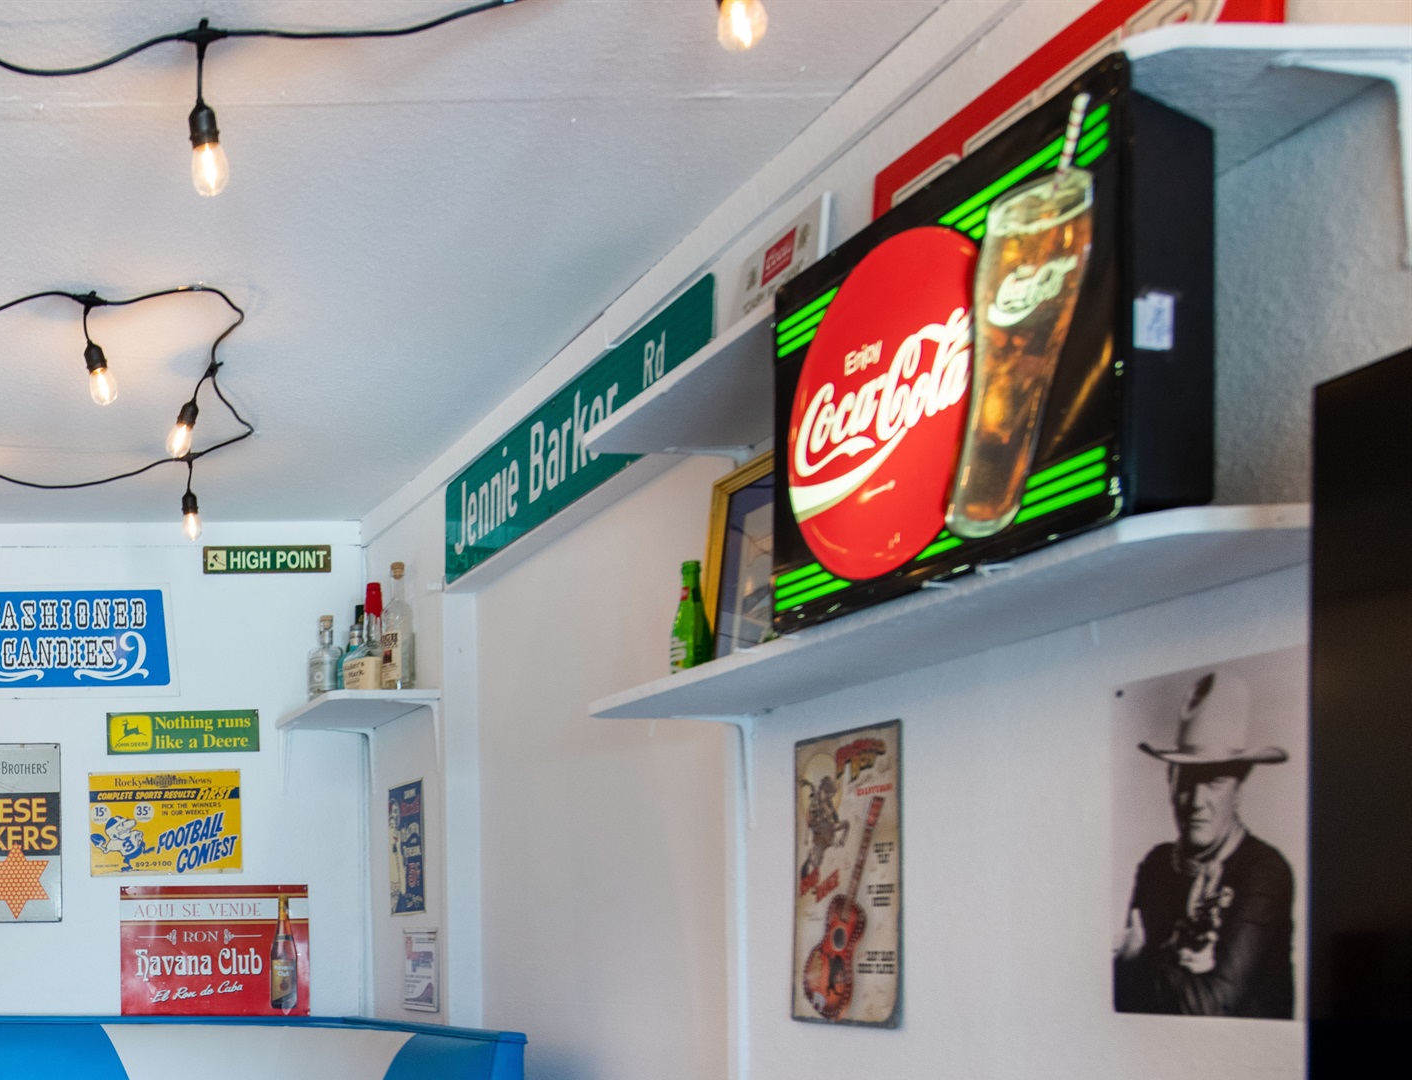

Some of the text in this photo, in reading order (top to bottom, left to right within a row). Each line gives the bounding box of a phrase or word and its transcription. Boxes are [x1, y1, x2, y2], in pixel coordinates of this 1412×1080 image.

[844, 340, 883, 376] Enjoy
[795, 307, 972, 478] Coca-Cola
[455, 446, 520, 555] Jennie
[642, 330, 666, 389] Rd
[229, 550, 327, 569] HIGH POINT
[0, 637, 118, 670] CANDIES
[155, 716, 251, 731] Nothing runs
[155, 734, 249, 749] like a Deere
[114, 777, 143, 788] Rocky
[189, 776, 212, 785] News
[97, 791, 134, 800] COMPLETE
[135, 790, 162, 799] SPORTS
[164, 790, 197, 799] RESULTS
[157, 812, 224, 854] FOOTBALL
[135, 860, 172, 868] 892-9100
[176, 835, 238, 873] CONTEST
[134, 902, 261, 918] AQUI SE VENDE
[182, 930, 219, 943] RON
[218, 948, 263, 976] Club
[151, 980, 243, 1004] El Ron de Cuba
